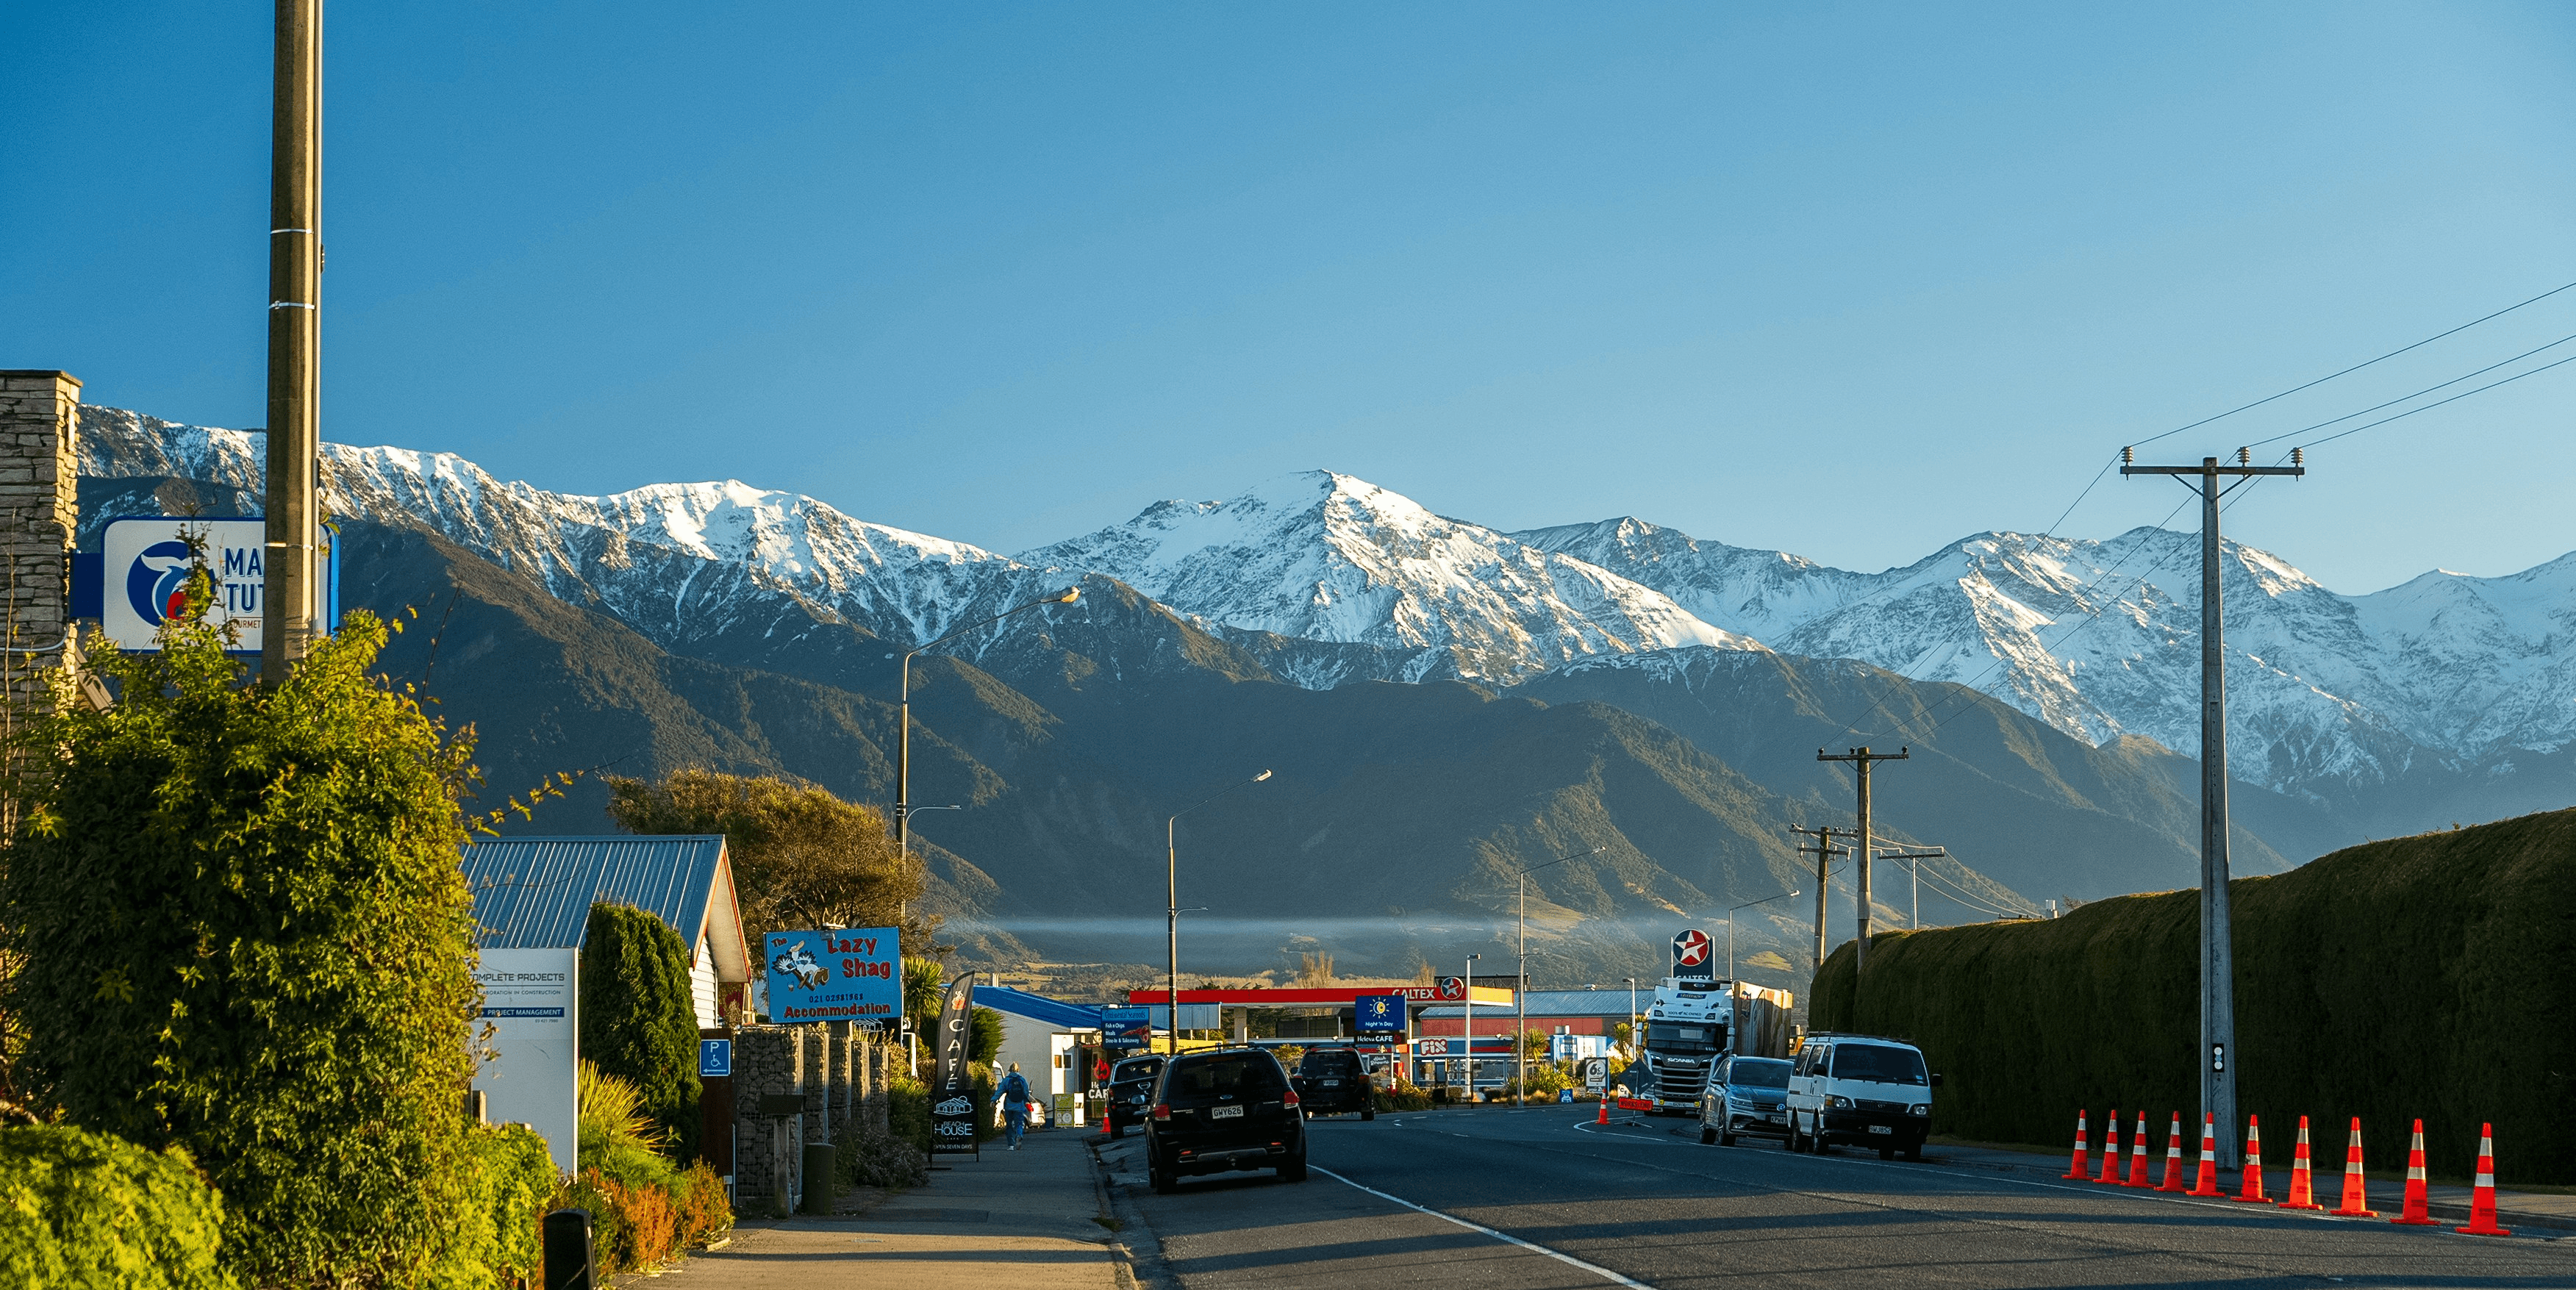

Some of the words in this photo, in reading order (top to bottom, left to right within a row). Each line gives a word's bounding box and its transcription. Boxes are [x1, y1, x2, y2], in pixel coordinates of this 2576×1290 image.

[225, 548, 265, 577] MA
[230, 620, 261, 628] OURMET
[771, 937, 788, 948] The
[826, 937, 878, 956] Lazy
[842, 958, 892, 980] Shag
[517, 973, 565, 981] PROJECTS
[809, 995, 823, 1003] 021
[784, 1003, 891, 1019] Accommodation
[710, 1042, 720, 1053] P
[1214, 1107, 1242, 1117] GWY626
[934, 1123, 973, 1136] HOUSE
